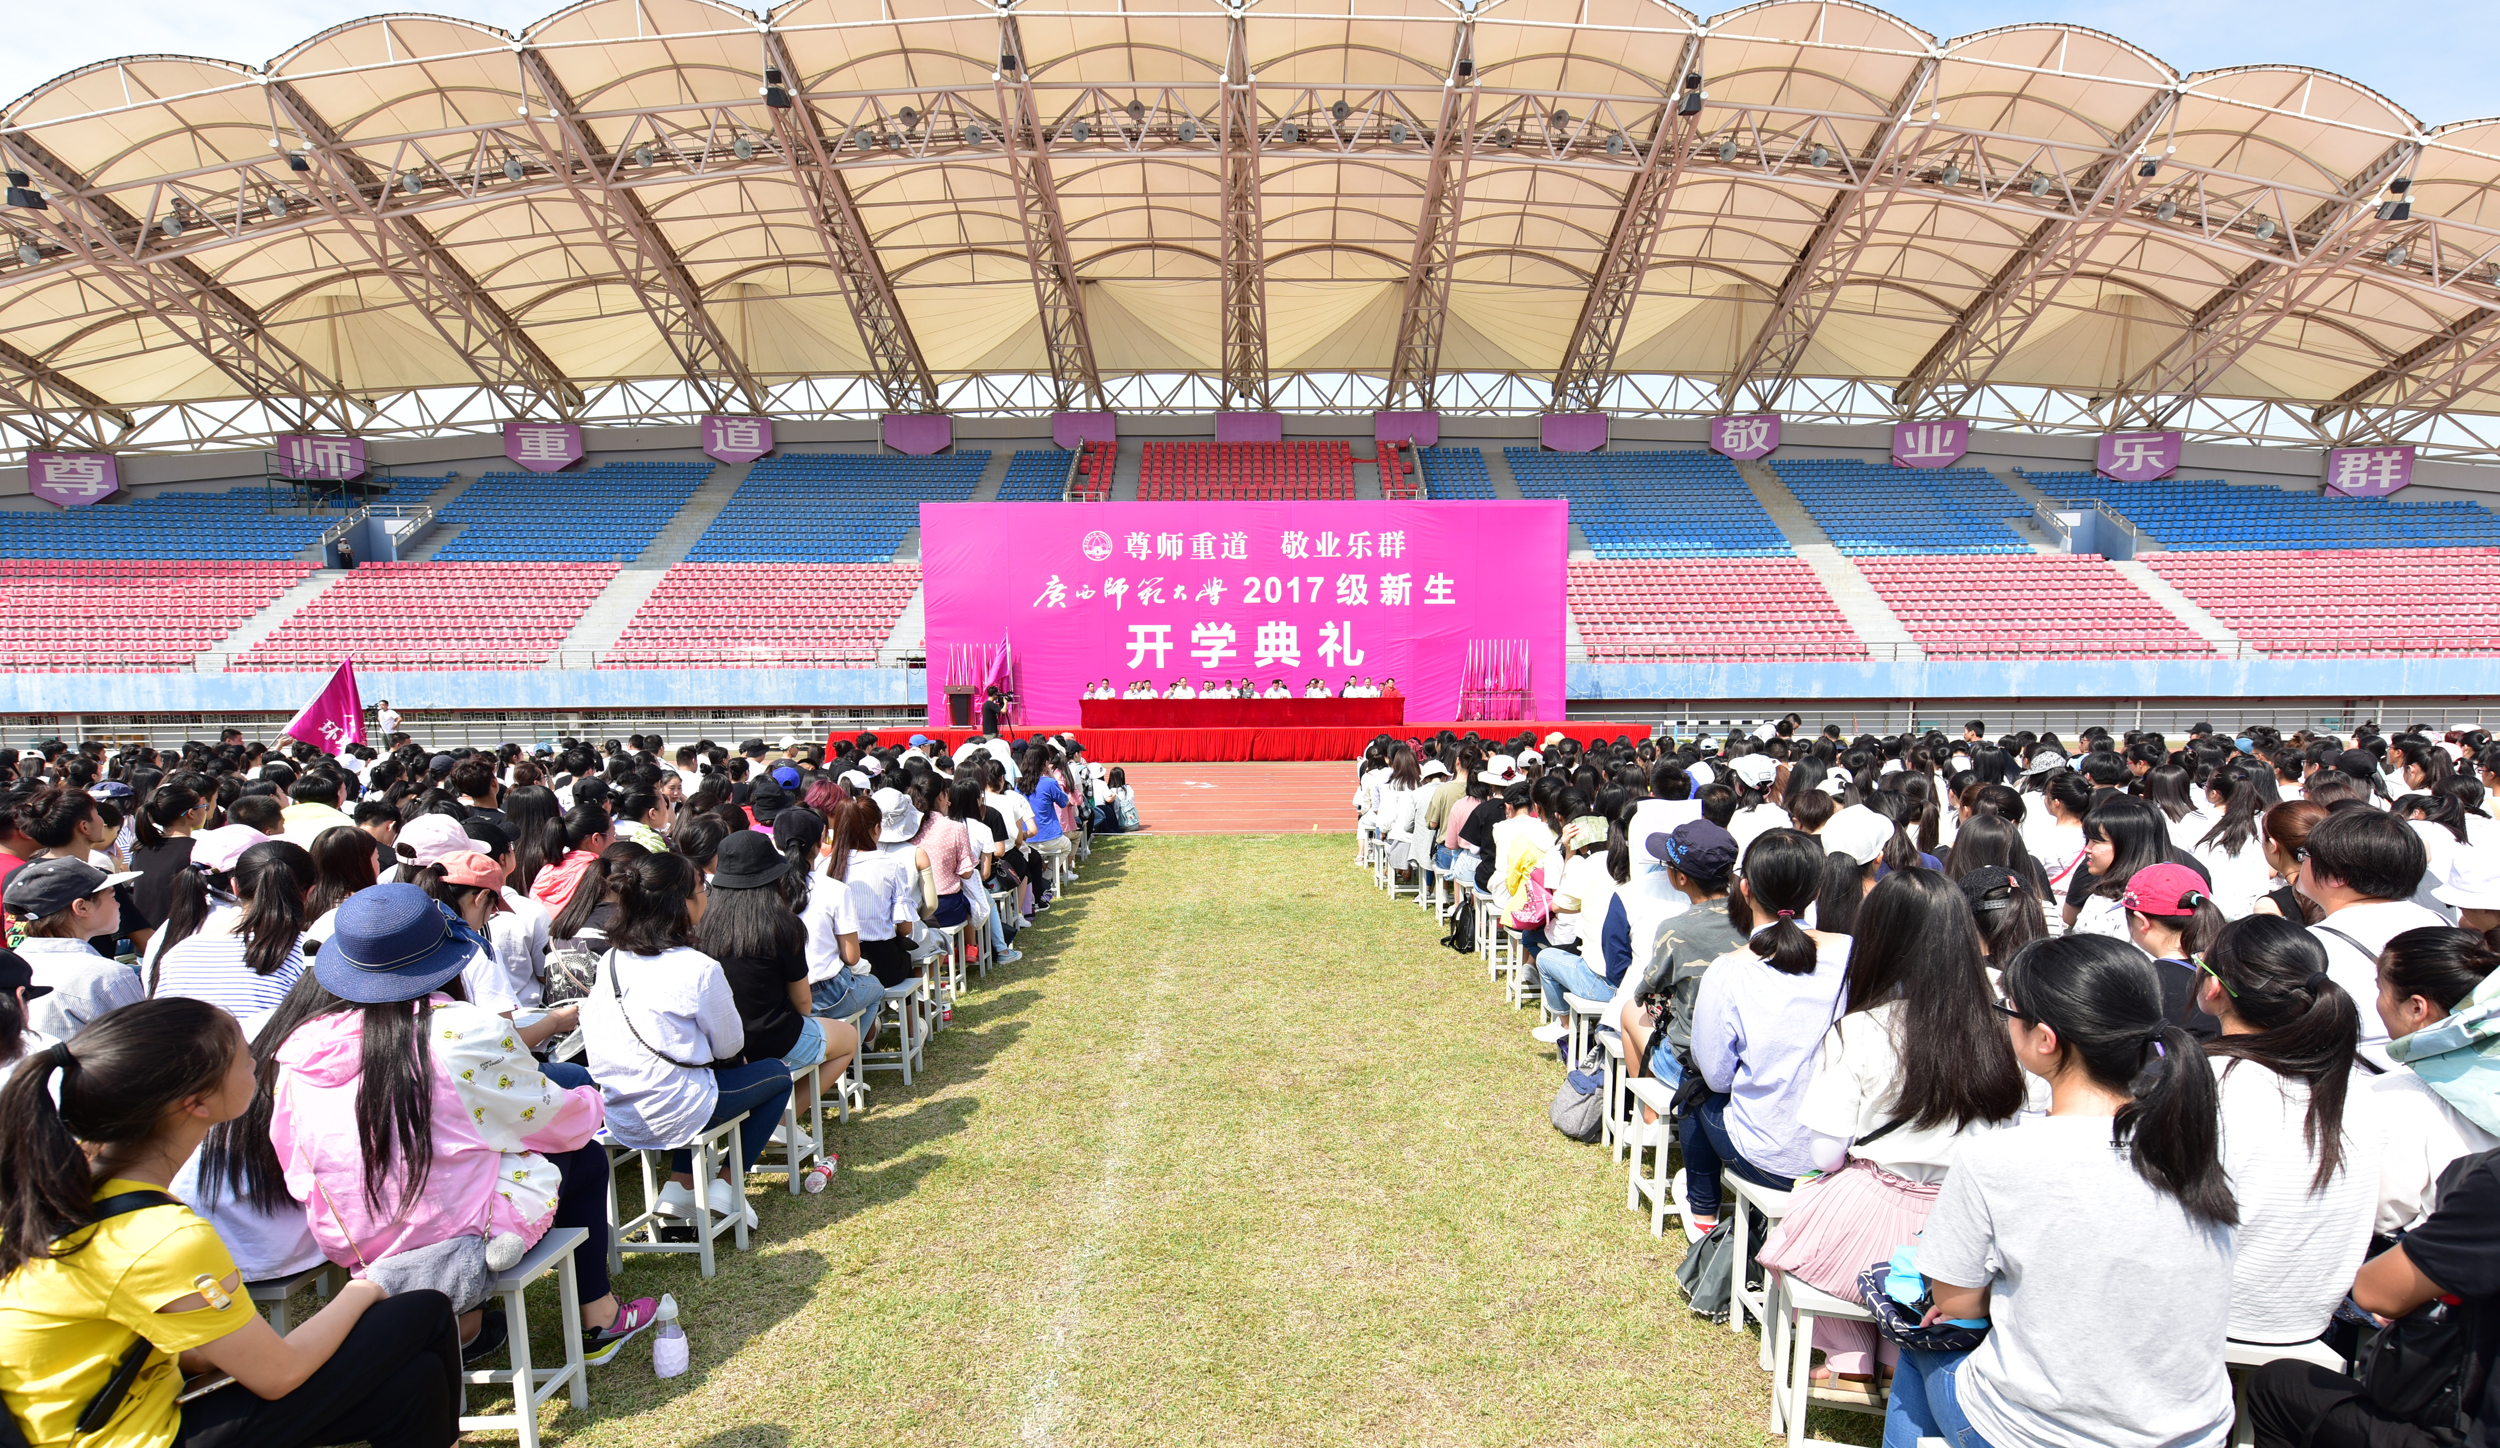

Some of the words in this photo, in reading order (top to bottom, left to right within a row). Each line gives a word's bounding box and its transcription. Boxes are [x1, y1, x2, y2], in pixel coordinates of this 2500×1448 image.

[516, 427, 572, 462] 重
[711, 419, 763, 453] 道
[1721, 419, 1771, 453] 敬
[1902, 425, 1955, 459] 业
[291, 439, 351, 477] 师
[2108, 436, 2165, 472] 乐
[2336, 450, 2403, 488] 群
[38, 456, 110, 496] 尊
[1124, 531, 1249, 561] 尊师重道
[1280, 530, 1407, 560] 敬业乐群
[1243, 576, 1325, 604] 2017
[1125, 620, 1365, 670] 开学典礼
[624, 1309, 638, 1330] N
